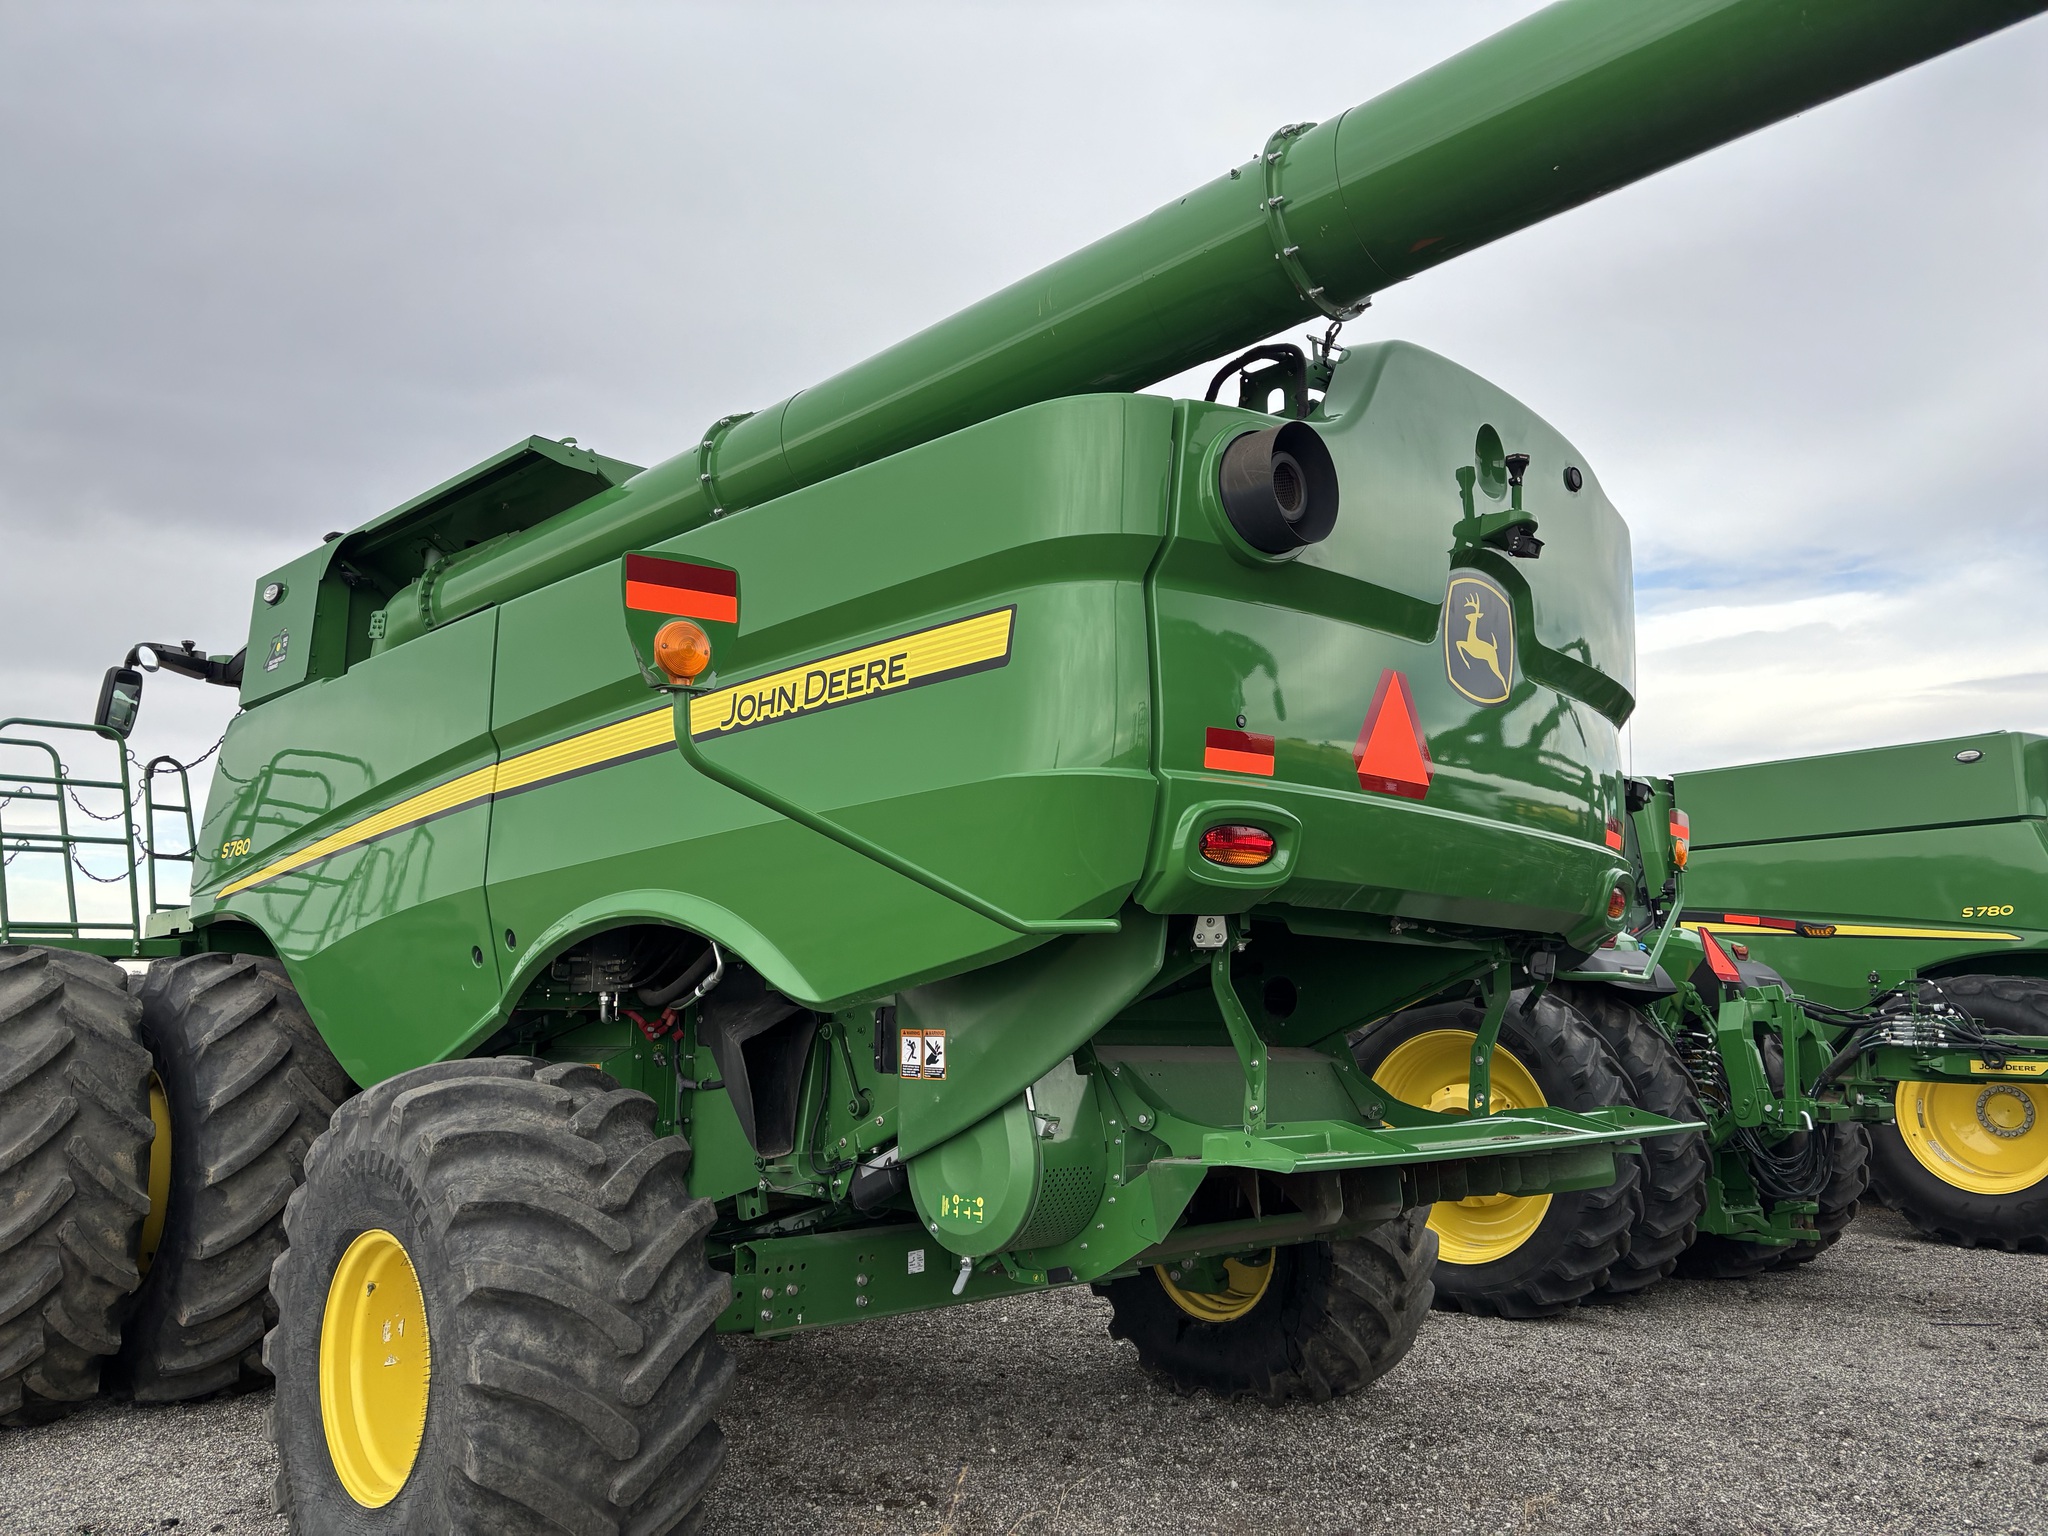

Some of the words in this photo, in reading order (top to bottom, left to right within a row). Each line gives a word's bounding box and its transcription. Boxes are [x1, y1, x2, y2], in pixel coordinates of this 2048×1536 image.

[720, 682, 797, 727] JOHN
[804, 652, 908, 705] DEERE
[221, 837, 251, 859] S780
[2006, 1064, 2037, 1072] DEERE
